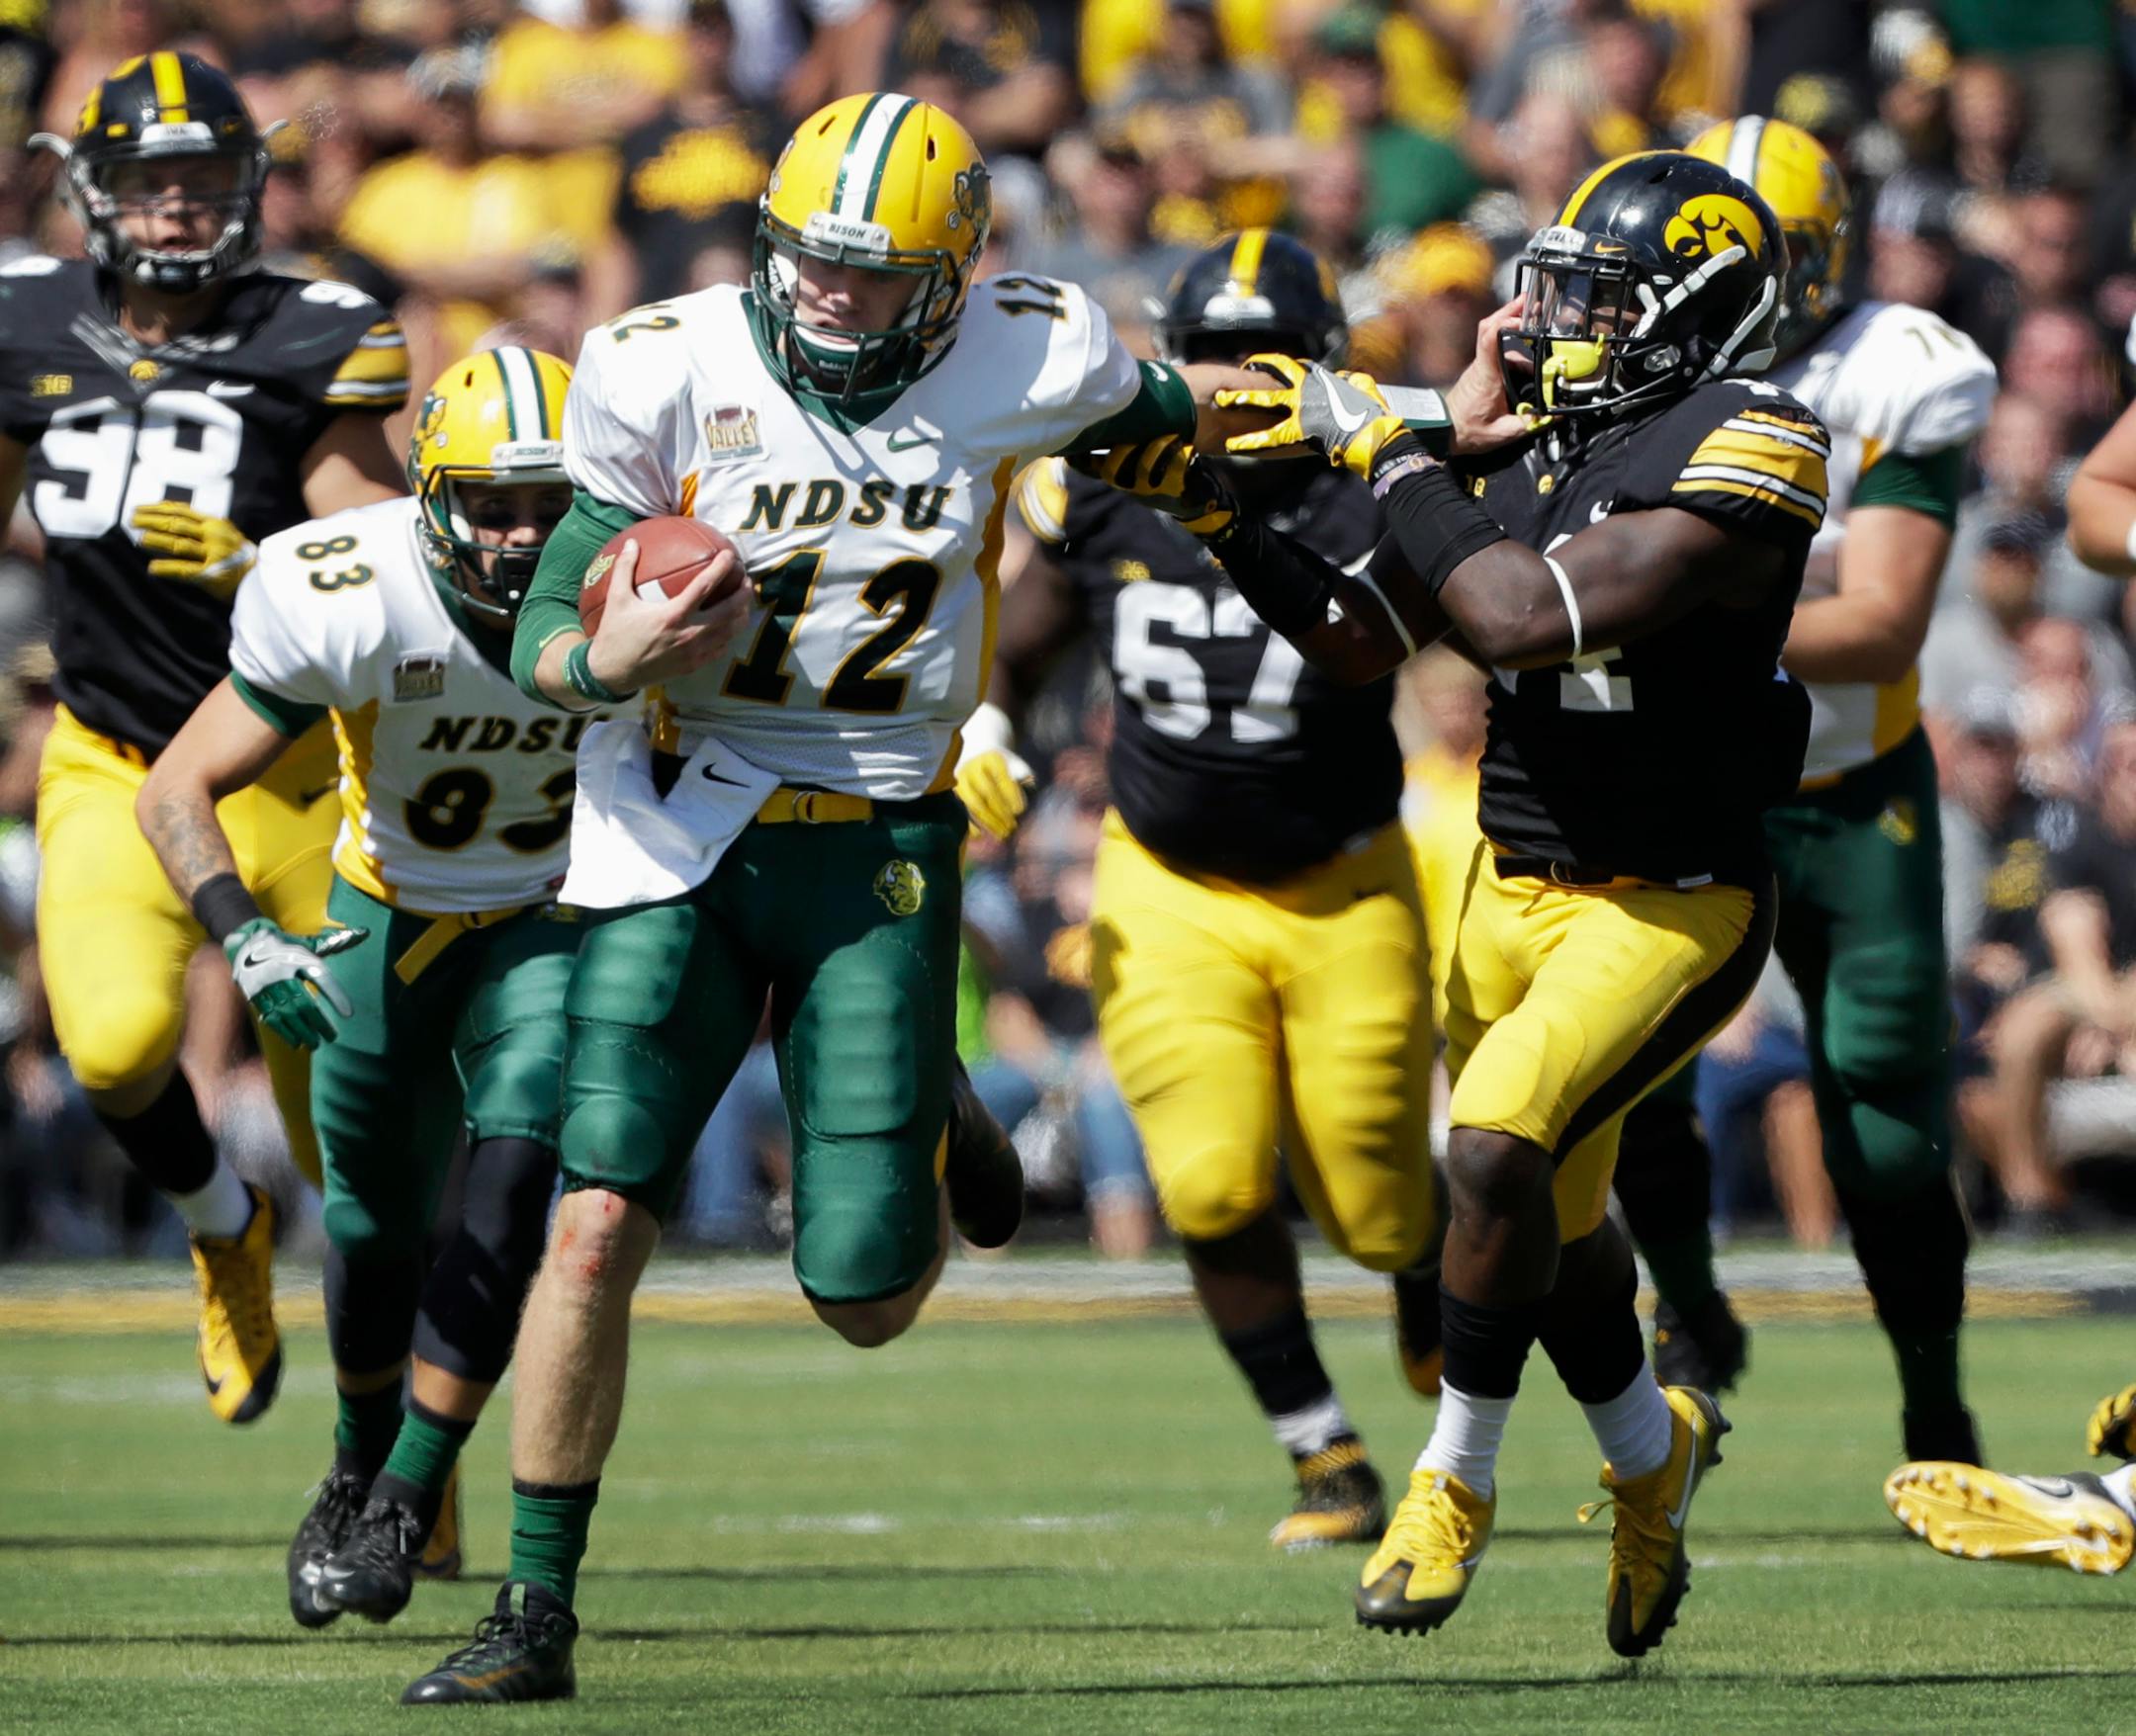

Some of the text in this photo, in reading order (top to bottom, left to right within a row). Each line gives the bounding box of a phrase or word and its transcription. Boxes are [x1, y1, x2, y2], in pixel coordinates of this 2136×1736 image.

[829, 222, 867, 239] BISON
[992, 277, 1068, 319] 12
[34, 390, 243, 546] 98
[738, 478, 956, 535] NDSU
[295, 535, 377, 594] 83
[719, 547, 944, 714] 12
[1112, 578, 1307, 743] 67
[416, 713, 611, 754] NDSU
[402, 765, 577, 854] 83
